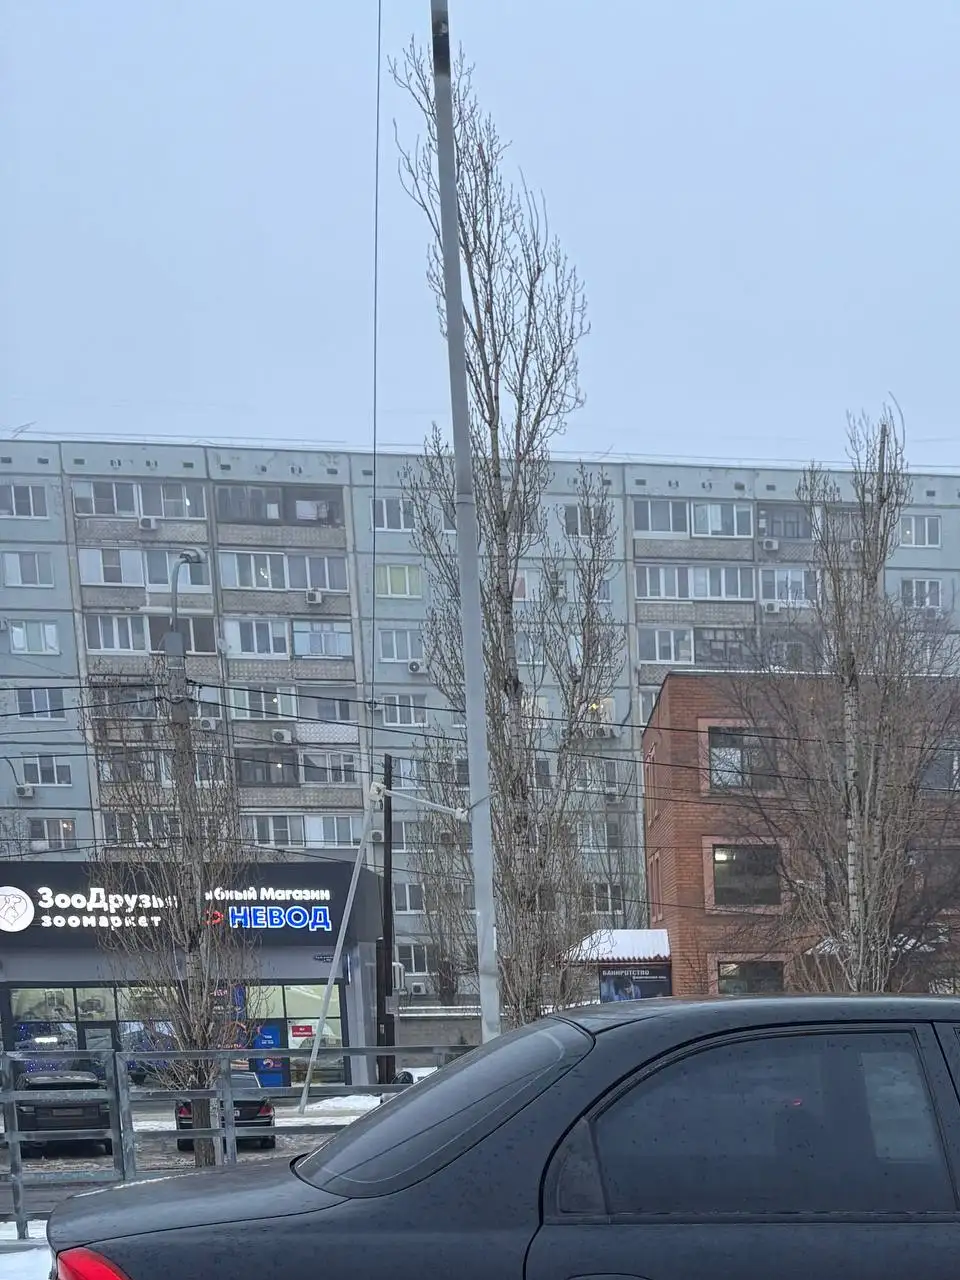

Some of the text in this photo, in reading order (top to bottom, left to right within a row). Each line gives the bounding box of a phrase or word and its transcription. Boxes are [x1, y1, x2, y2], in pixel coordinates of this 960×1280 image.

[260, 887, 331, 901] Магазин
[41, 915, 162, 931] зоомаркет
[229, 906, 332, 931] НЕВОД
